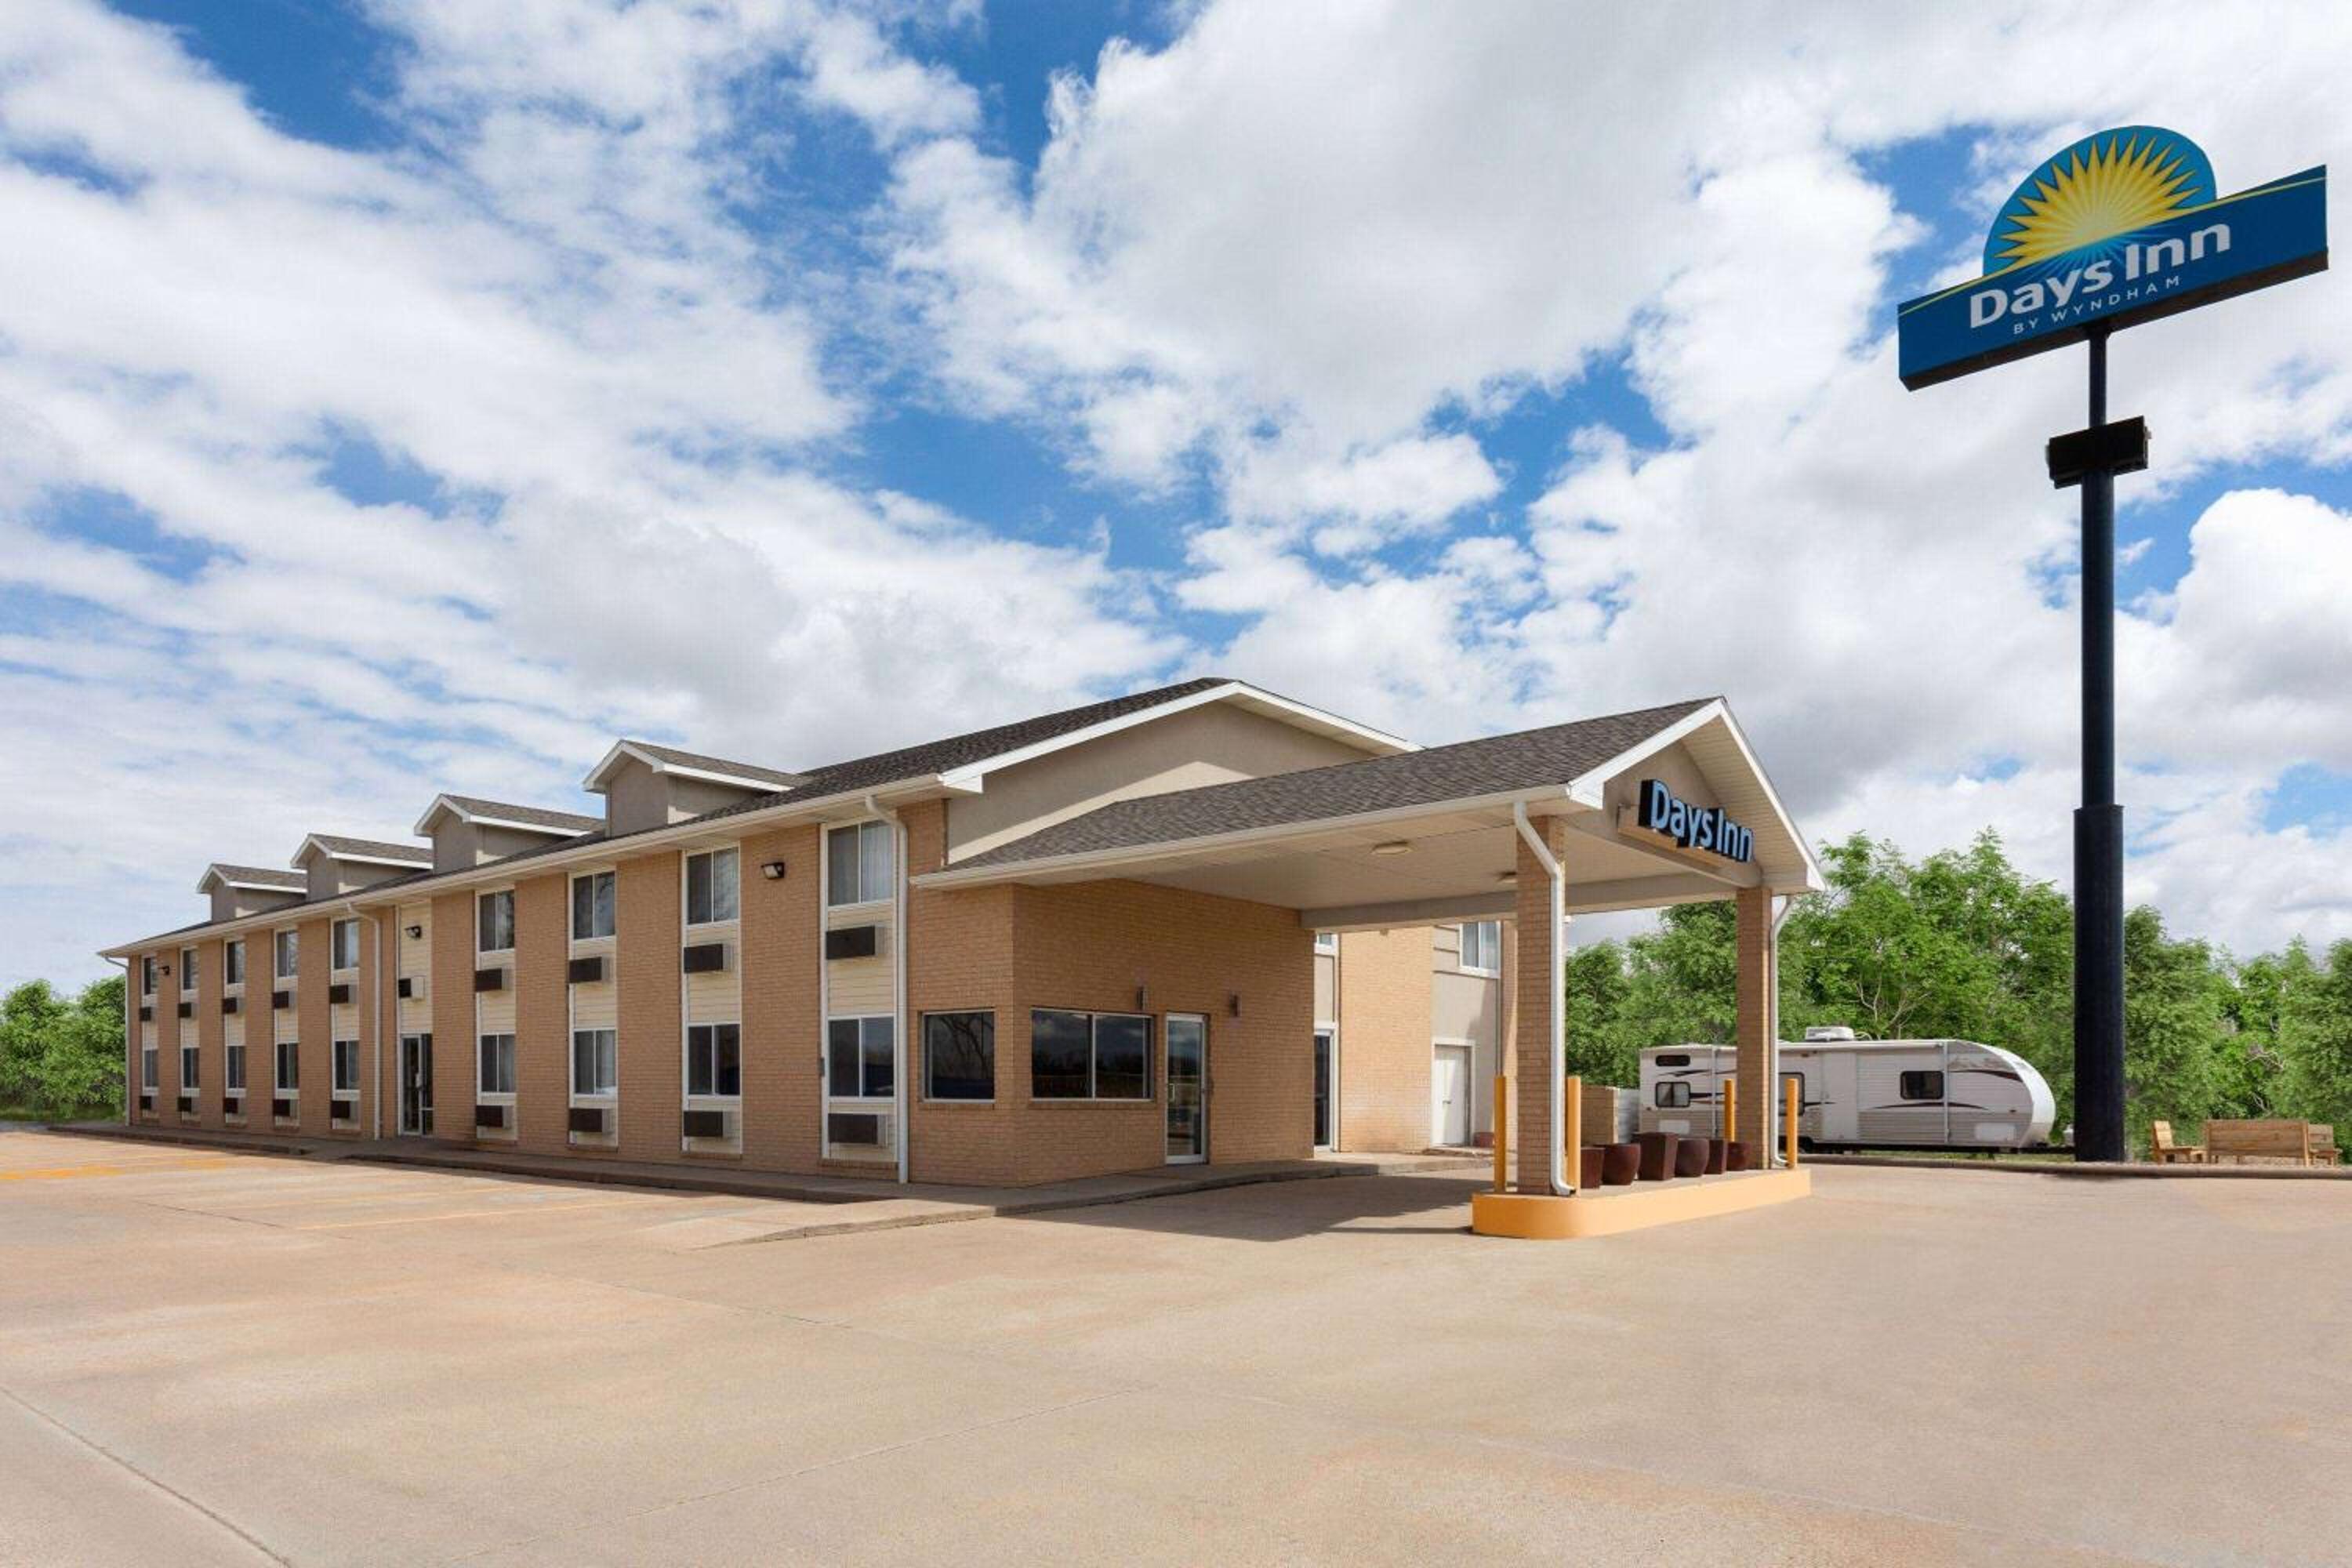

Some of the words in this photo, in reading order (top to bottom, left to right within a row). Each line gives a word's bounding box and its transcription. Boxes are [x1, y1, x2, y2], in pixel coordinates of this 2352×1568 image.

[1970, 260, 2114, 328] Days
[2126, 223, 2230, 280] Inn
[2013, 318, 2039, 336] BY
[2051, 275, 2180, 323] WYNDHAM
[1649, 779, 1714, 848] Days
[1716, 808, 1754, 862] Inn
